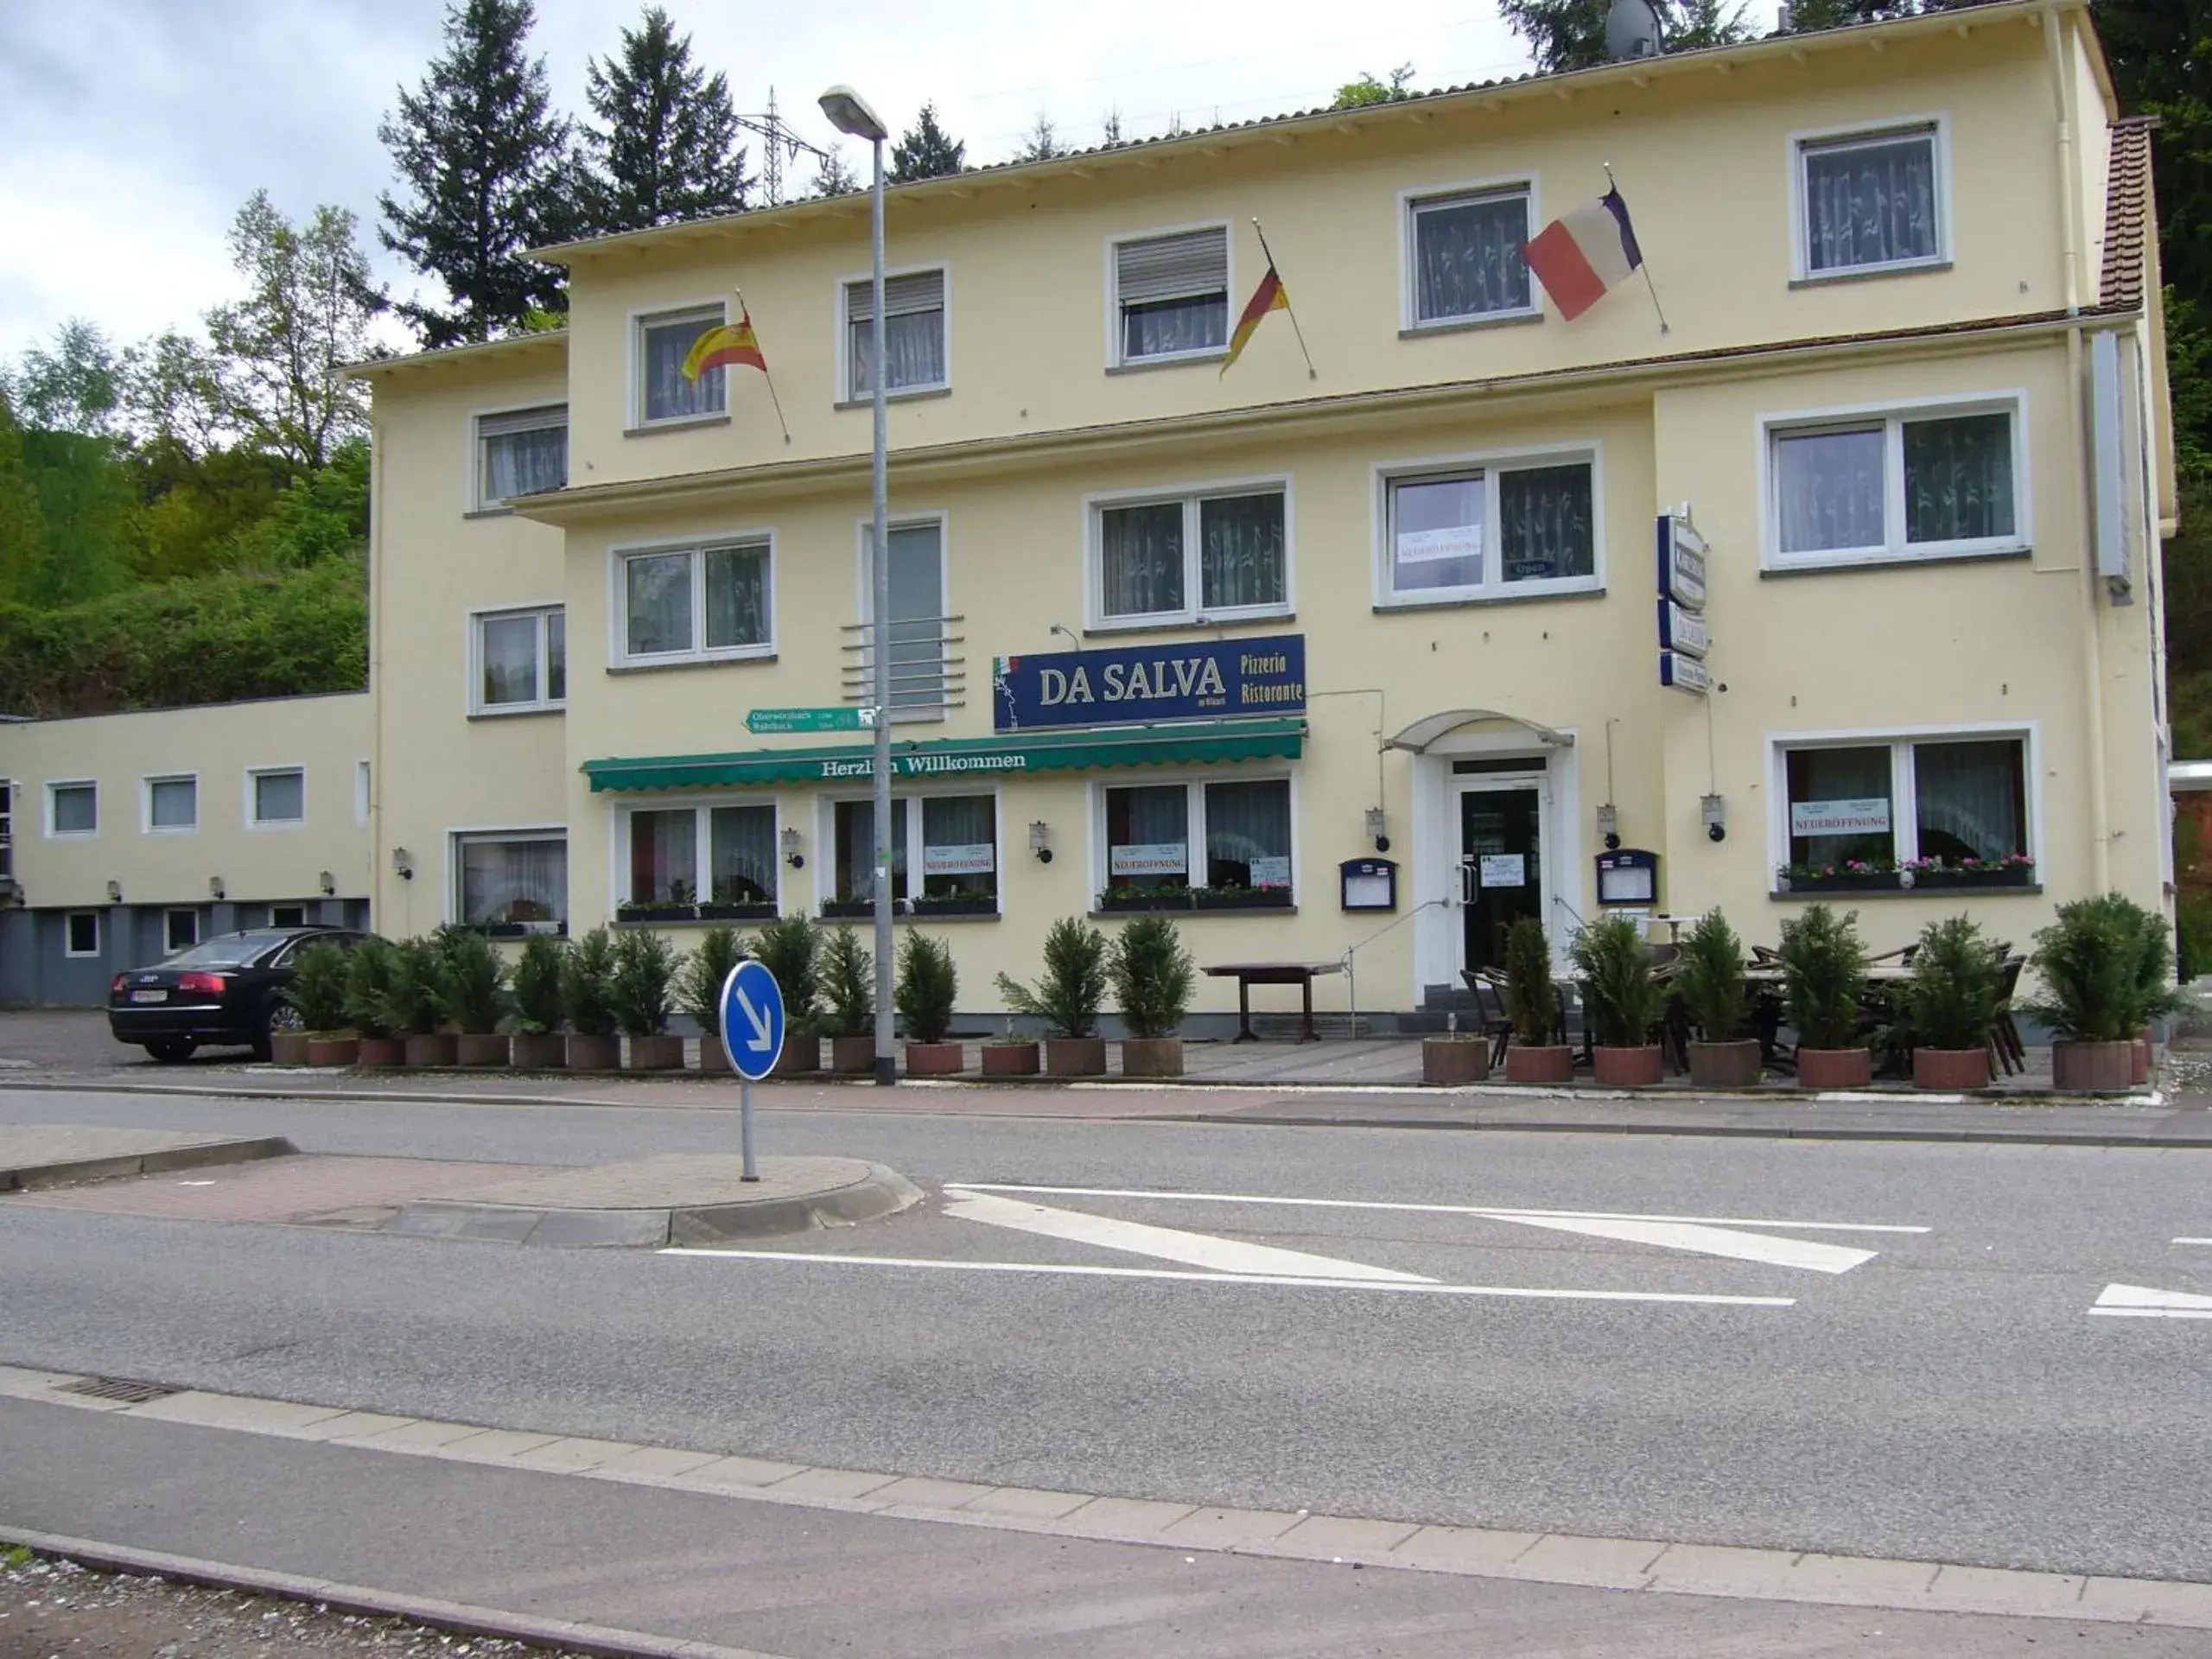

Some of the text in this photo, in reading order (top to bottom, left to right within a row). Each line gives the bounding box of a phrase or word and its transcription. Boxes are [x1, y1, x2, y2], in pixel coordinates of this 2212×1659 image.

[1240, 652, 1287, 676] Pizzeria
[1039, 657, 1226, 705] DA SALVA
[1241, 681, 1304, 704] Ristorante
[822, 755, 1027, 777] Herzlh Willkommen
